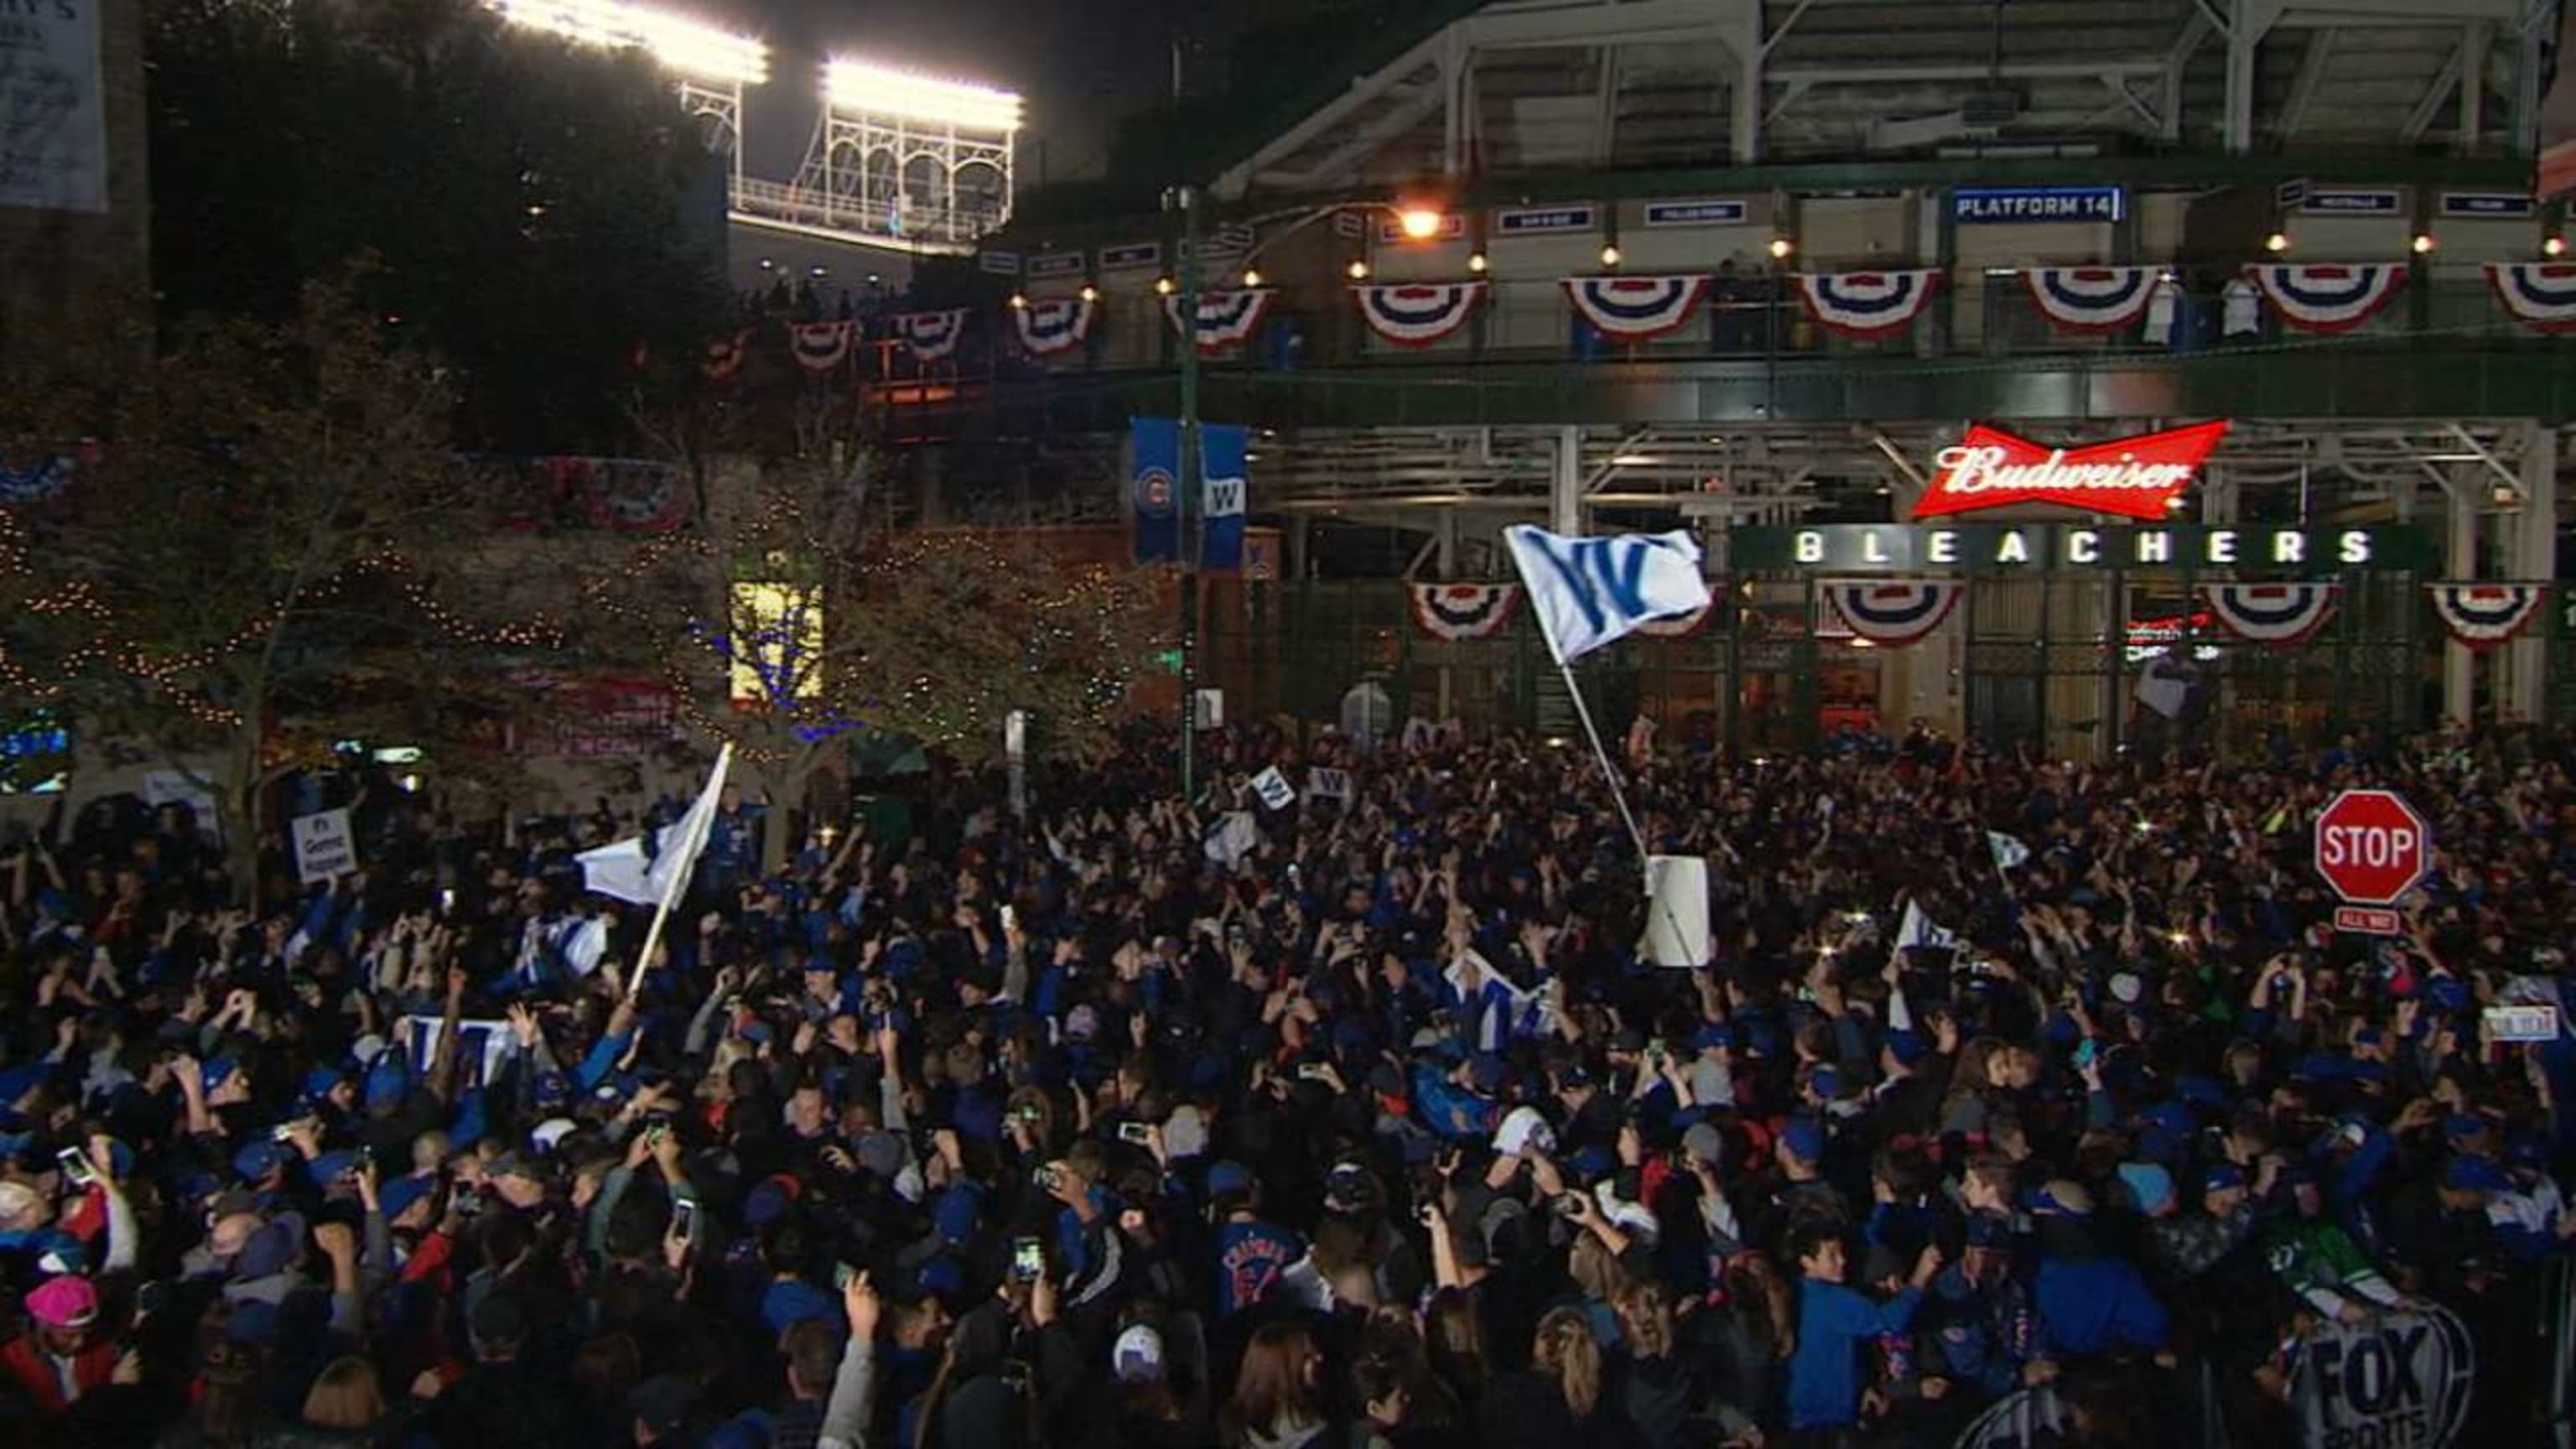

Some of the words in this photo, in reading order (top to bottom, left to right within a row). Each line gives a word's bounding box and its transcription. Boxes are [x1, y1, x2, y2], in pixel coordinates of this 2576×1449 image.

[1957, 196, 2078, 216] PLATFORM
[2085, 196, 2110, 213] 14
[1936, 446, 2190, 492] Budweiser
[1213, 482, 1239, 511] W
[1795, 531, 2371, 564] BLEACHERS
[1320, 771, 1343, 792] W
[2324, 824, 2414, 868] STOP
[2311, 1325, 2429, 1431] FOX
